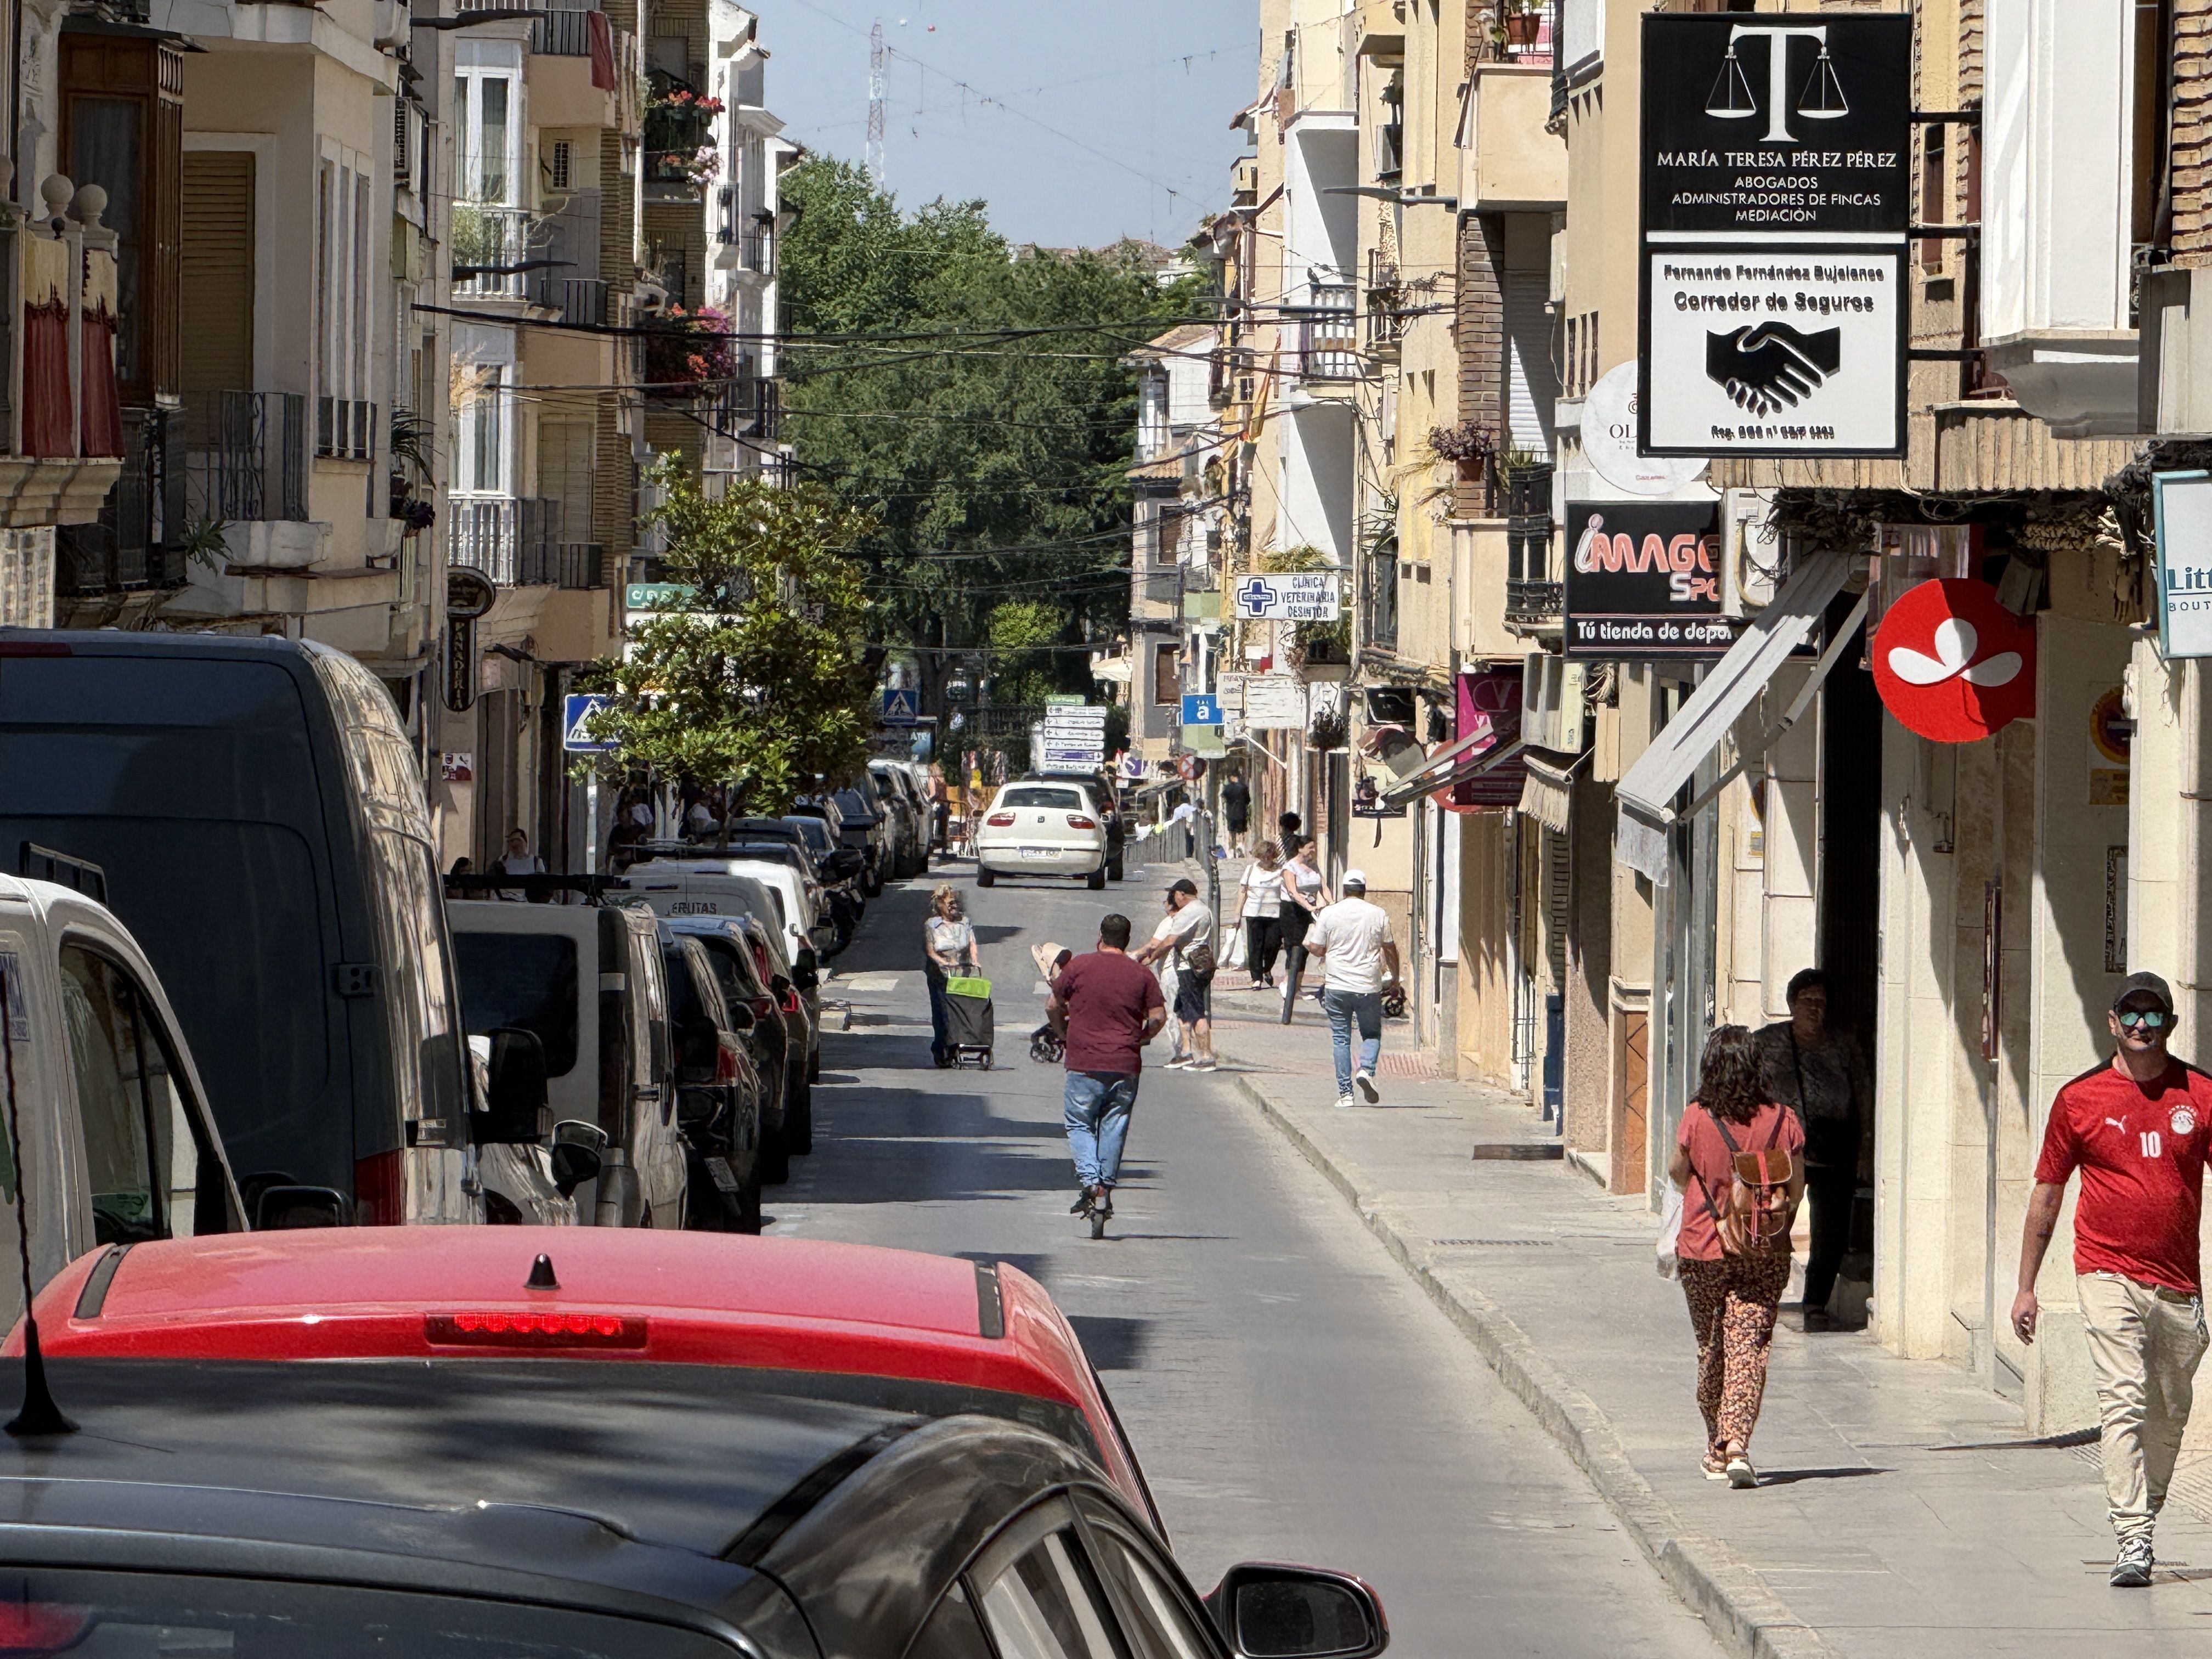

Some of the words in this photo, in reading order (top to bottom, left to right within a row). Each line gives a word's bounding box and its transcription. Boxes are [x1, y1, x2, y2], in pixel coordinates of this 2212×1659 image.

[1657, 150, 1719, 167] MARÍA
[1725, 153, 1786, 167] TERESA
[1791, 150, 1842, 167] PÉREZ
[1847, 150, 1897, 168] PÉREZ
[1735, 177, 1818, 189] ABOGADOS
[1672, 193, 1804, 206] ADMINISTRADORES
[1809, 194, 1827, 205] DE
[1831, 193, 1881, 206] FINCAS
[1735, 207, 1816, 222] MEDIACIÓN
[1664, 264, 1731, 281] Fernando
[1674, 291, 1760, 312] Corredor
[1765, 292, 1788, 312] de
[1795, 292, 1874, 315] Seguros
[2168, 601, 2210, 611] BOUT
[1577, 621, 1595, 639] Tú
[1600, 622, 1654, 640] tienda
[1658, 622, 1679, 640] de
[2140, 1131, 2161, 1158] 10
